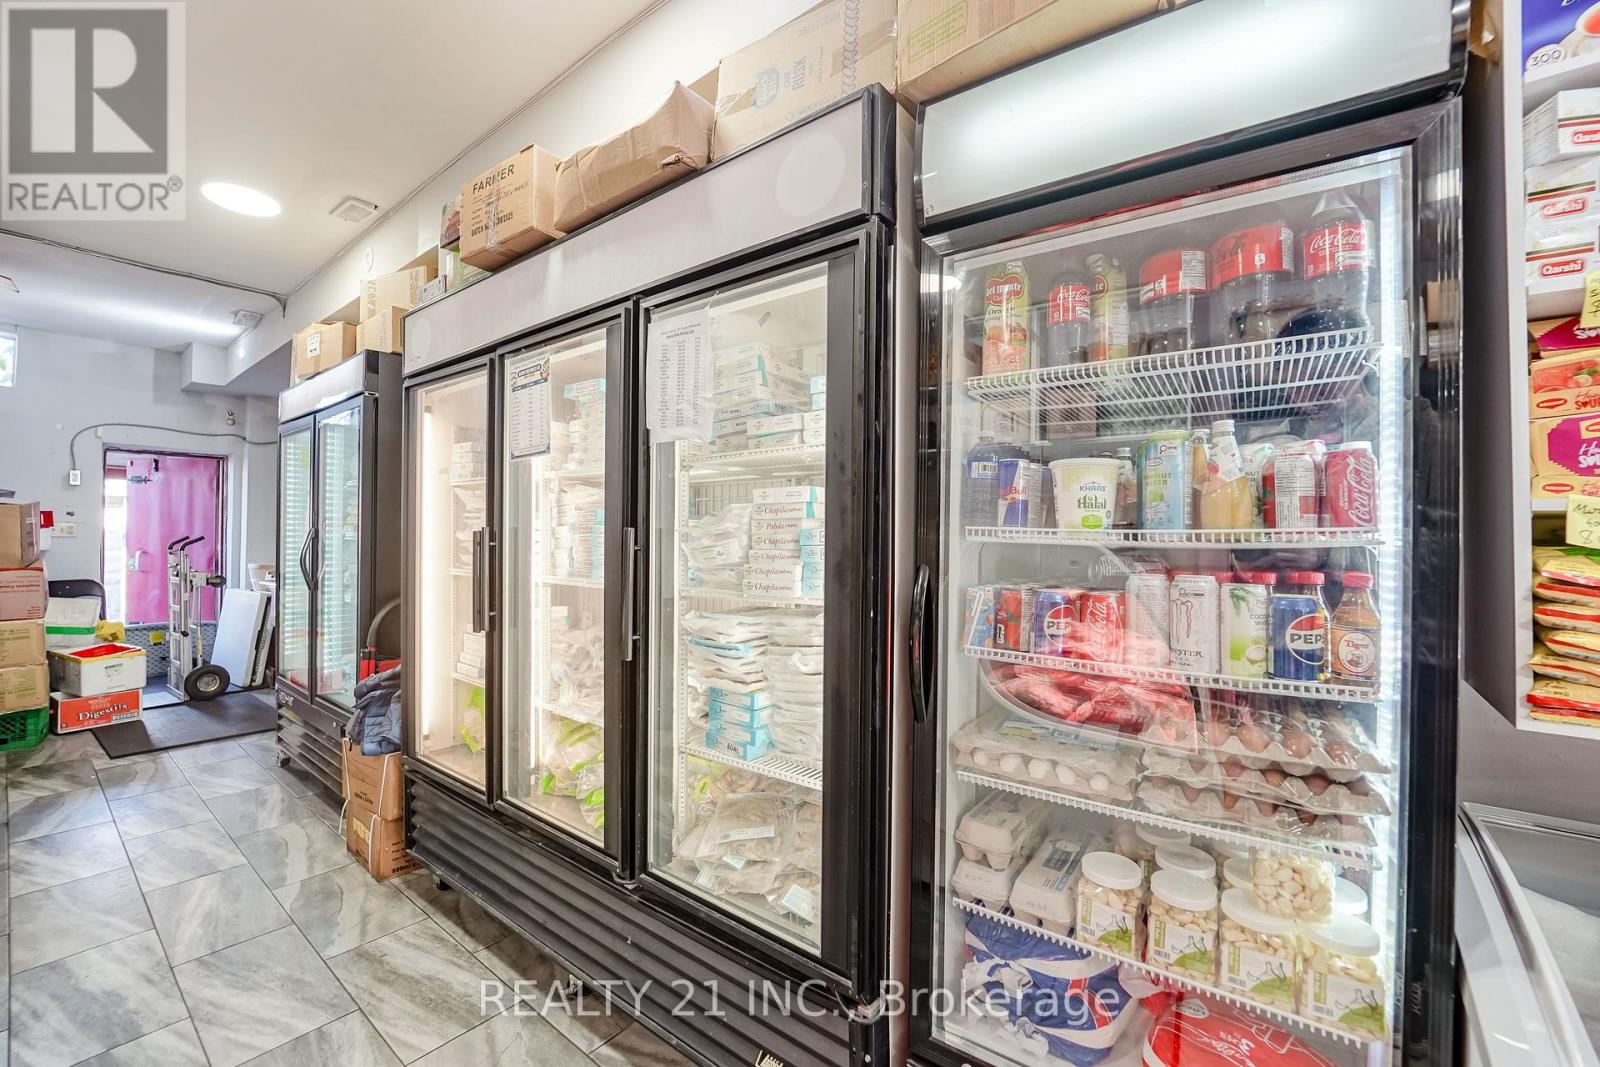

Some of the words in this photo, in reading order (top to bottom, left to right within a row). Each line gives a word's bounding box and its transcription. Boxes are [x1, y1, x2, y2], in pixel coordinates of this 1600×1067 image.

[1531, 49, 1562, 66] 300
[1543, 260, 1584, 275] Qarshi
[1077, 493, 1107, 509] Halal
